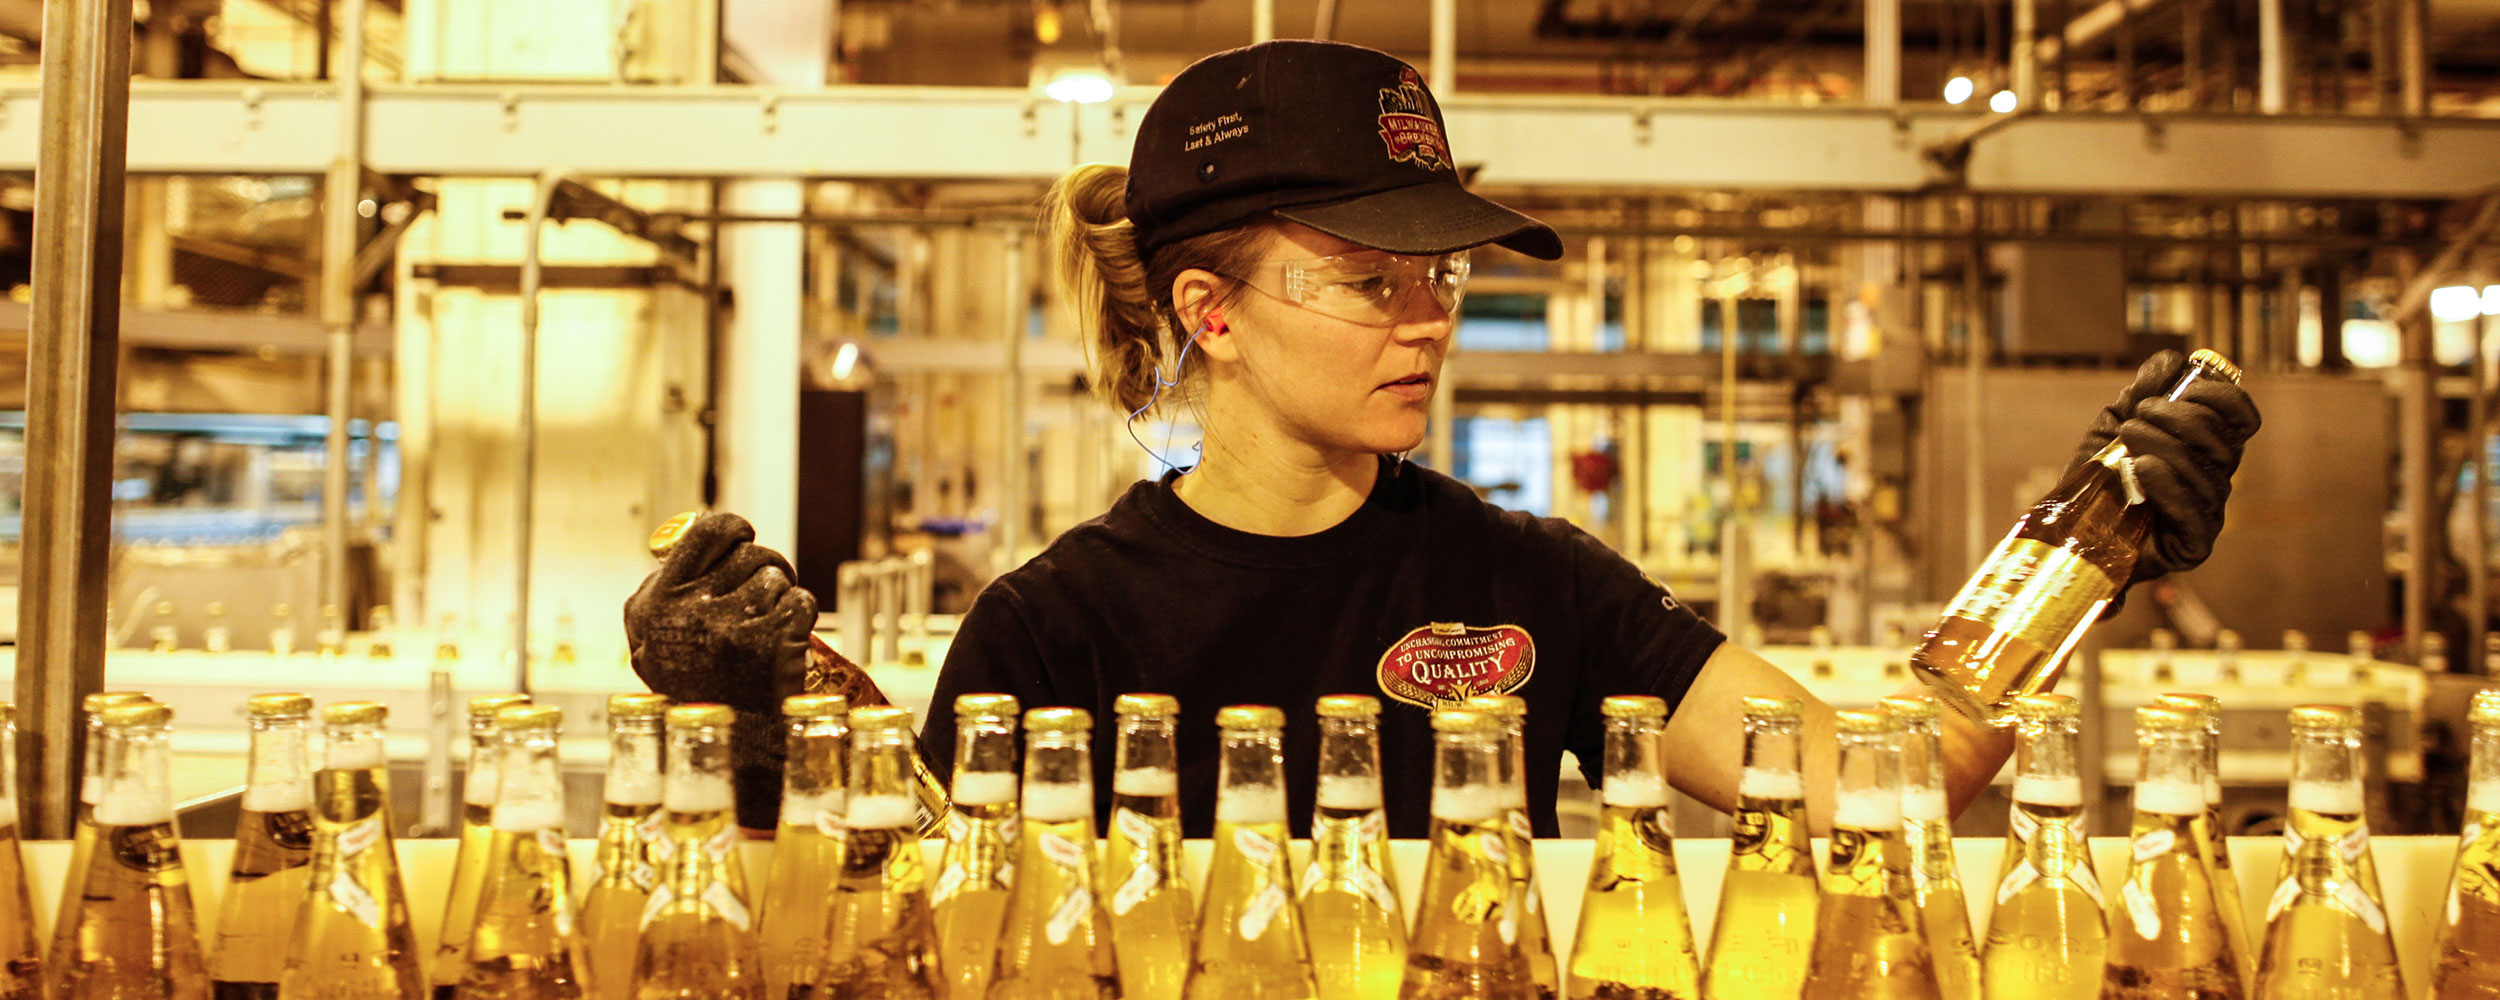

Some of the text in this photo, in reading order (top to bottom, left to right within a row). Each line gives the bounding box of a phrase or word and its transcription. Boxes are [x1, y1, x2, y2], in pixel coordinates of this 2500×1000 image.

[1184, 125, 1249, 152] Last & Always
[1189, 121, 1216, 136] Safety
[1396, 637, 1516, 667] TO UNCOMPROMISING
[1445, 630, 1503, 647] COMMITMENT
[1411, 650, 1505, 685] QUALITY
